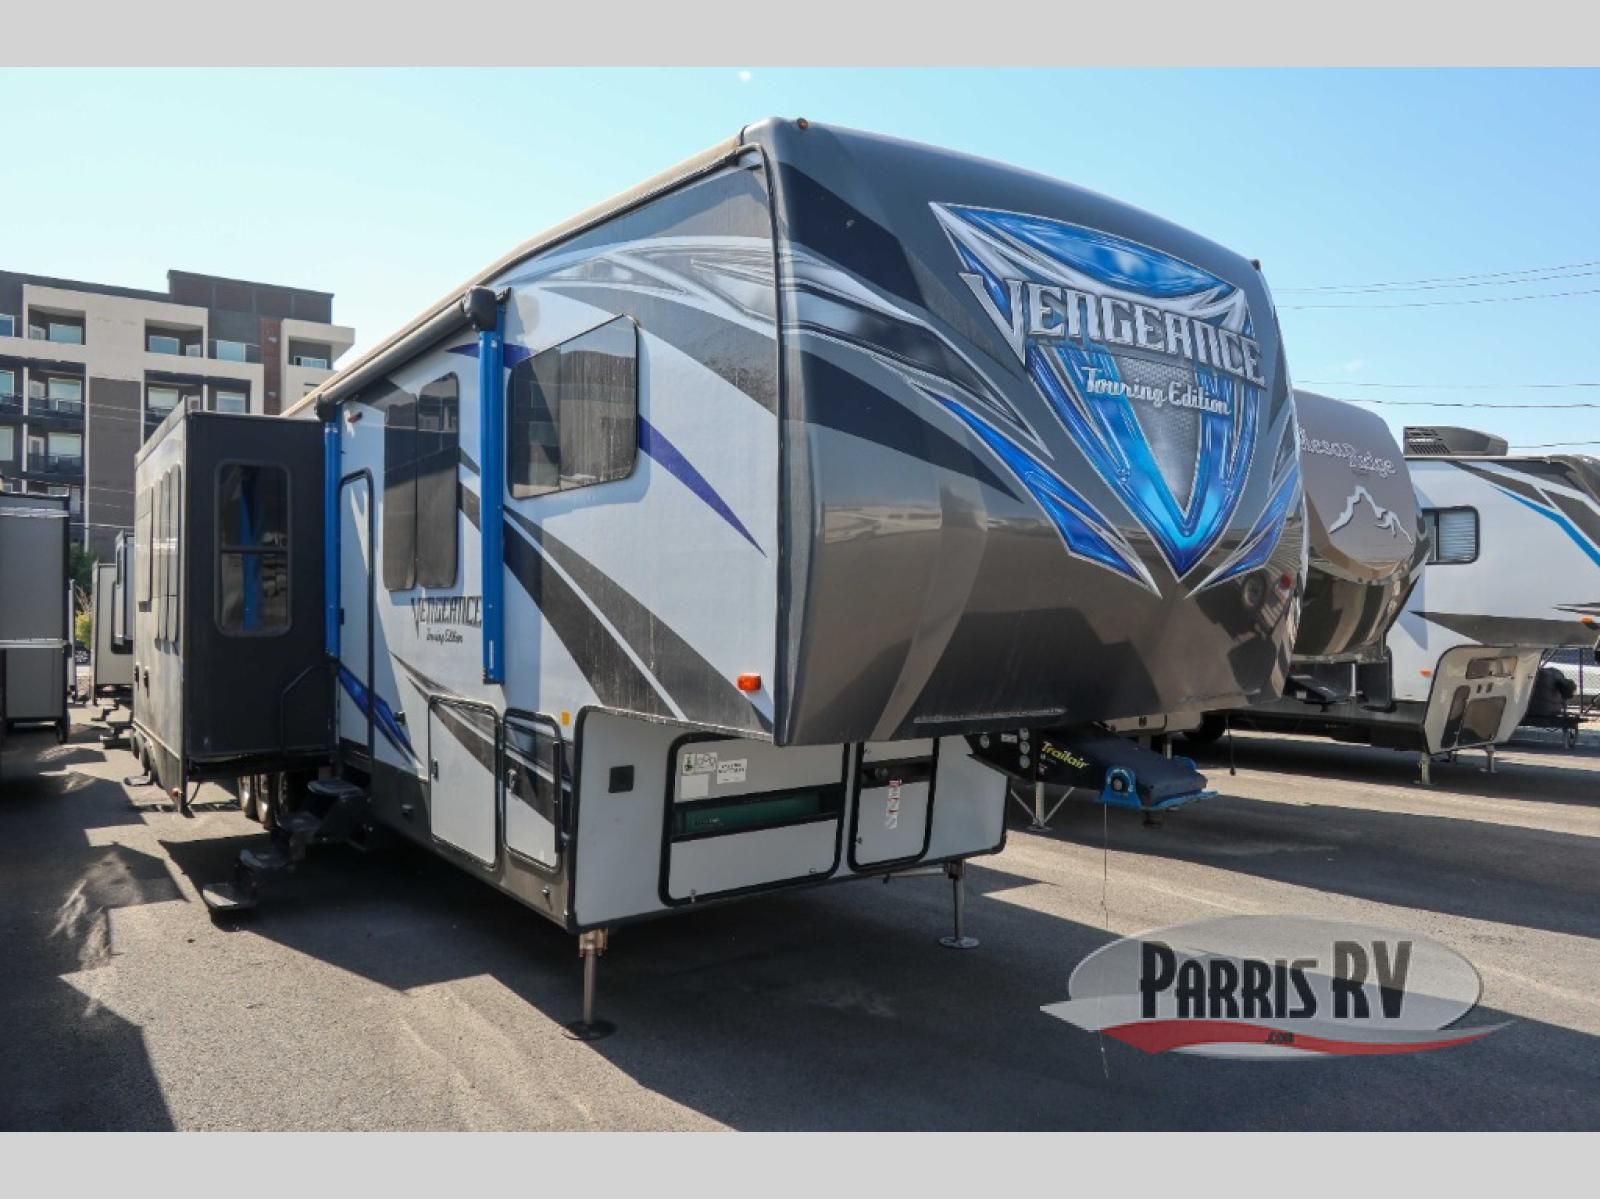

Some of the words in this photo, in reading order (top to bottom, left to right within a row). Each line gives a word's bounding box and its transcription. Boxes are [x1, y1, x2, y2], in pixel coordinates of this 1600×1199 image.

[959, 272, 1267, 388] VENGEANCE
[1081, 366, 1168, 408] Touring
[1168, 381, 1232, 415] Edition
